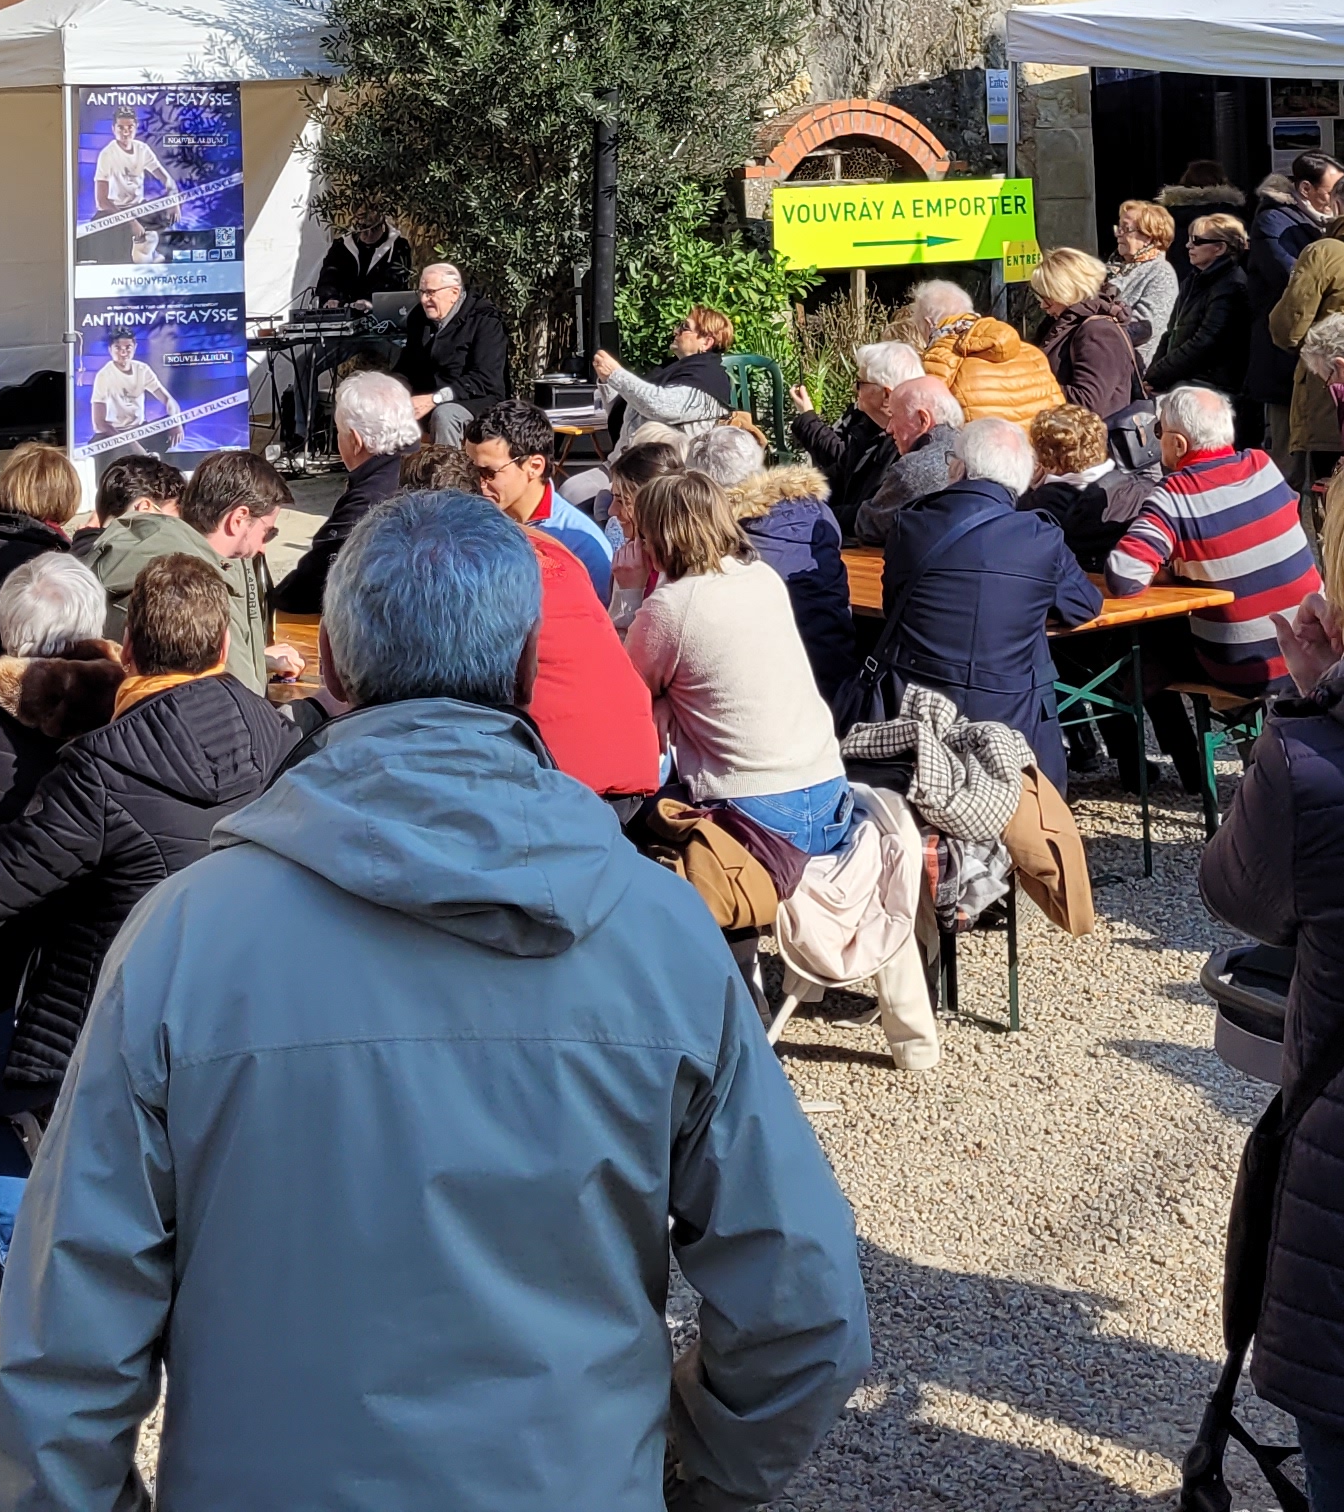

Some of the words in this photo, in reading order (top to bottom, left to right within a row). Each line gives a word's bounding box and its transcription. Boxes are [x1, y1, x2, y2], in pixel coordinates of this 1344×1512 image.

[86, 91, 160, 106] ANTHONY
[165, 92, 233, 106] FRAYSSE
[167, 137, 196, 145] NOUVEL
[85, 221, 97, 232] EN
[138, 203, 160, 217] DANS
[782, 200, 885, 224] VOUVRAY
[892, 200, 905, 219] A
[913, 195, 1027, 219] EMPORTER
[111, 275, 207, 286] ANTHONYFRAYSSE.FR
[82, 310, 160, 327] ANTHONY
[165, 308, 239, 324] FRAYSSE
[167, 355, 200, 363] NOUVEL
[201, 353, 229, 361] ALBUM
[81, 443, 95, 456] EN
[138, 424, 161, 438] DANS
[161, 412, 191, 429] TOUTE
[192, 408, 203, 418] LA
[204, 395, 239, 414] FRANCE
